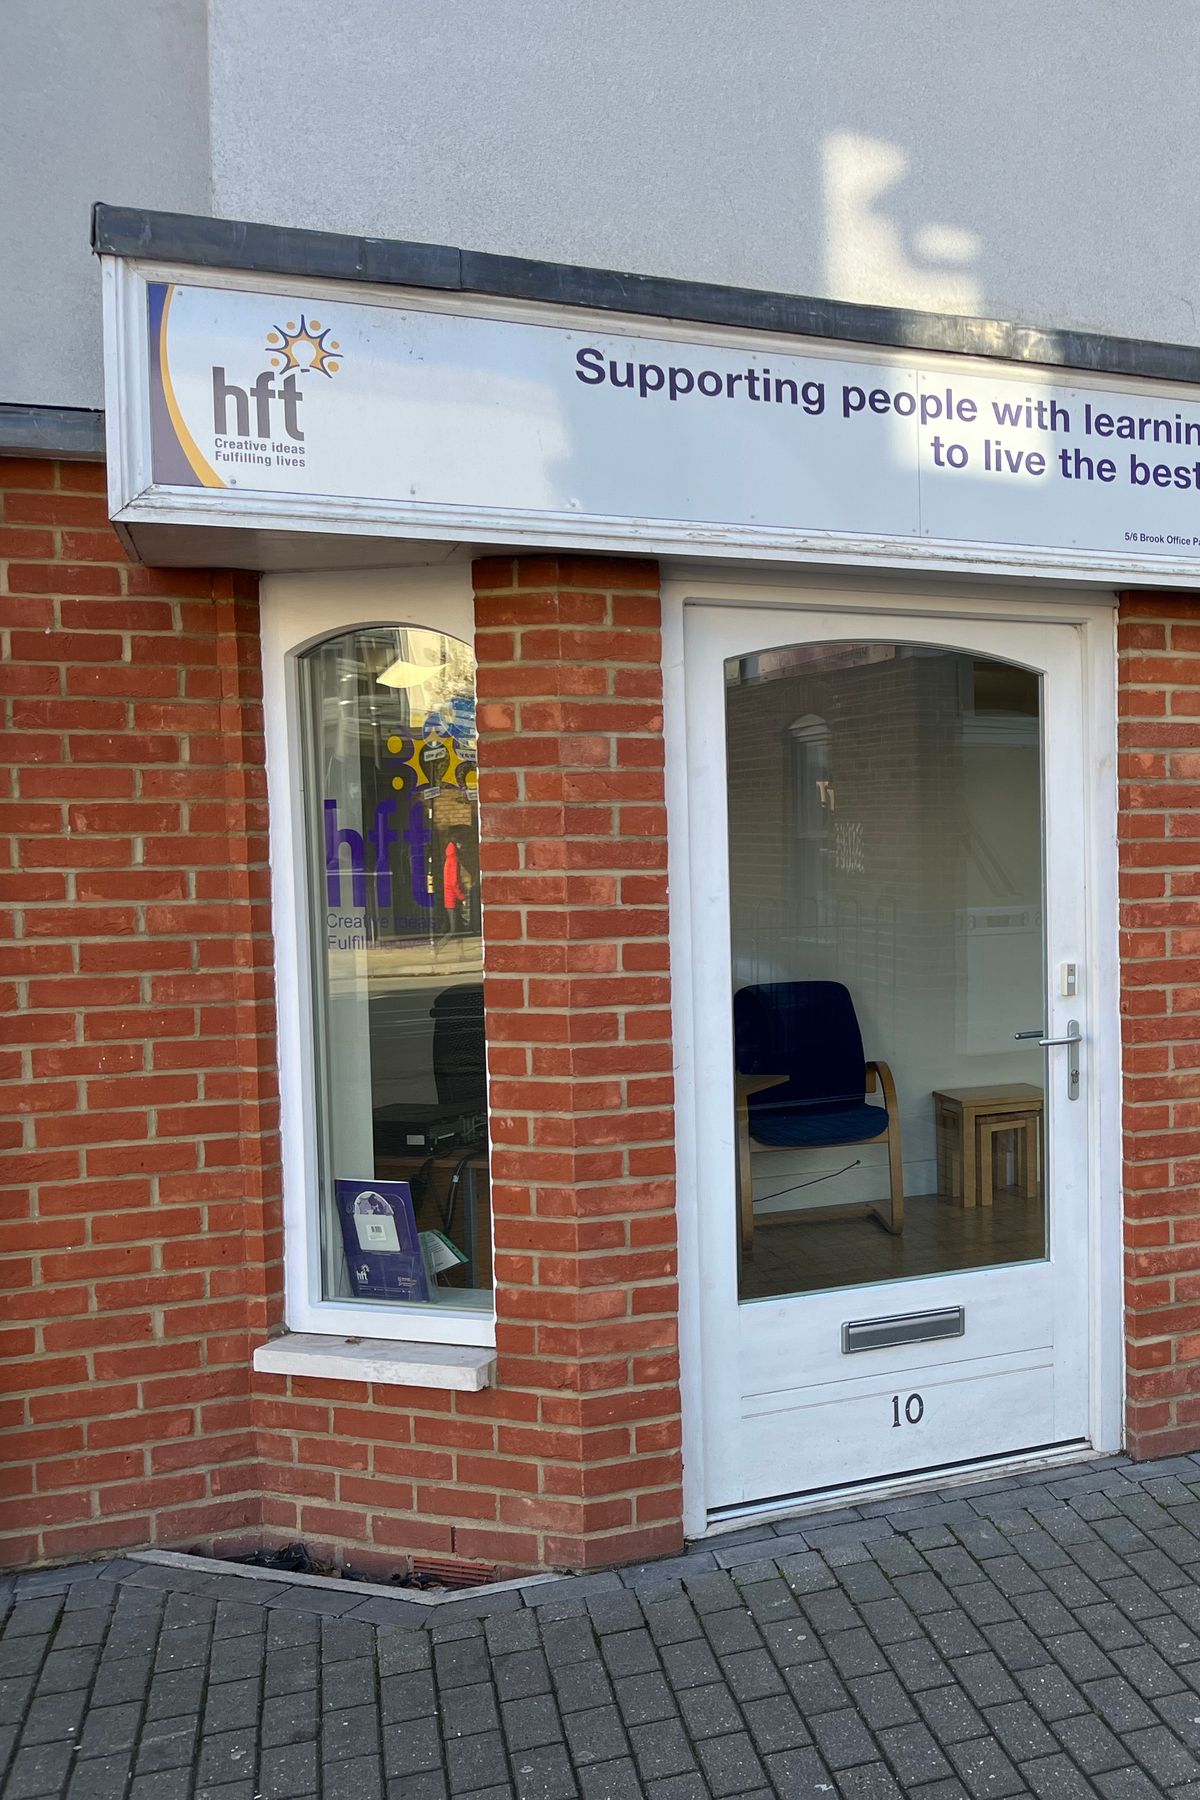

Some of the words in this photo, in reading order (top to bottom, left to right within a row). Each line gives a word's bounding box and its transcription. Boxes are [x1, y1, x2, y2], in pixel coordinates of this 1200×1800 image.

[212, 366, 304, 441] hft
[575, 347, 825, 415] Supporting
[842, 385, 977, 425] people
[992, 397, 1070, 433] with
[214, 438, 267, 452] Creative
[271, 442, 305, 454] ideas
[215, 451, 271, 466] Fulfilling
[276, 456, 305, 467] lives
[930, 436, 968, 468] to
[984, 439, 1046, 475] live
[1058, 448, 1116, 482] the
[1124, 532, 1138, 541] 5/6
[1140, 533, 1164, 544] Brook
[1166, 535, 1191, 545] Office
[323, 798, 435, 908] hft
[892, 1393, 924, 1427] 10
